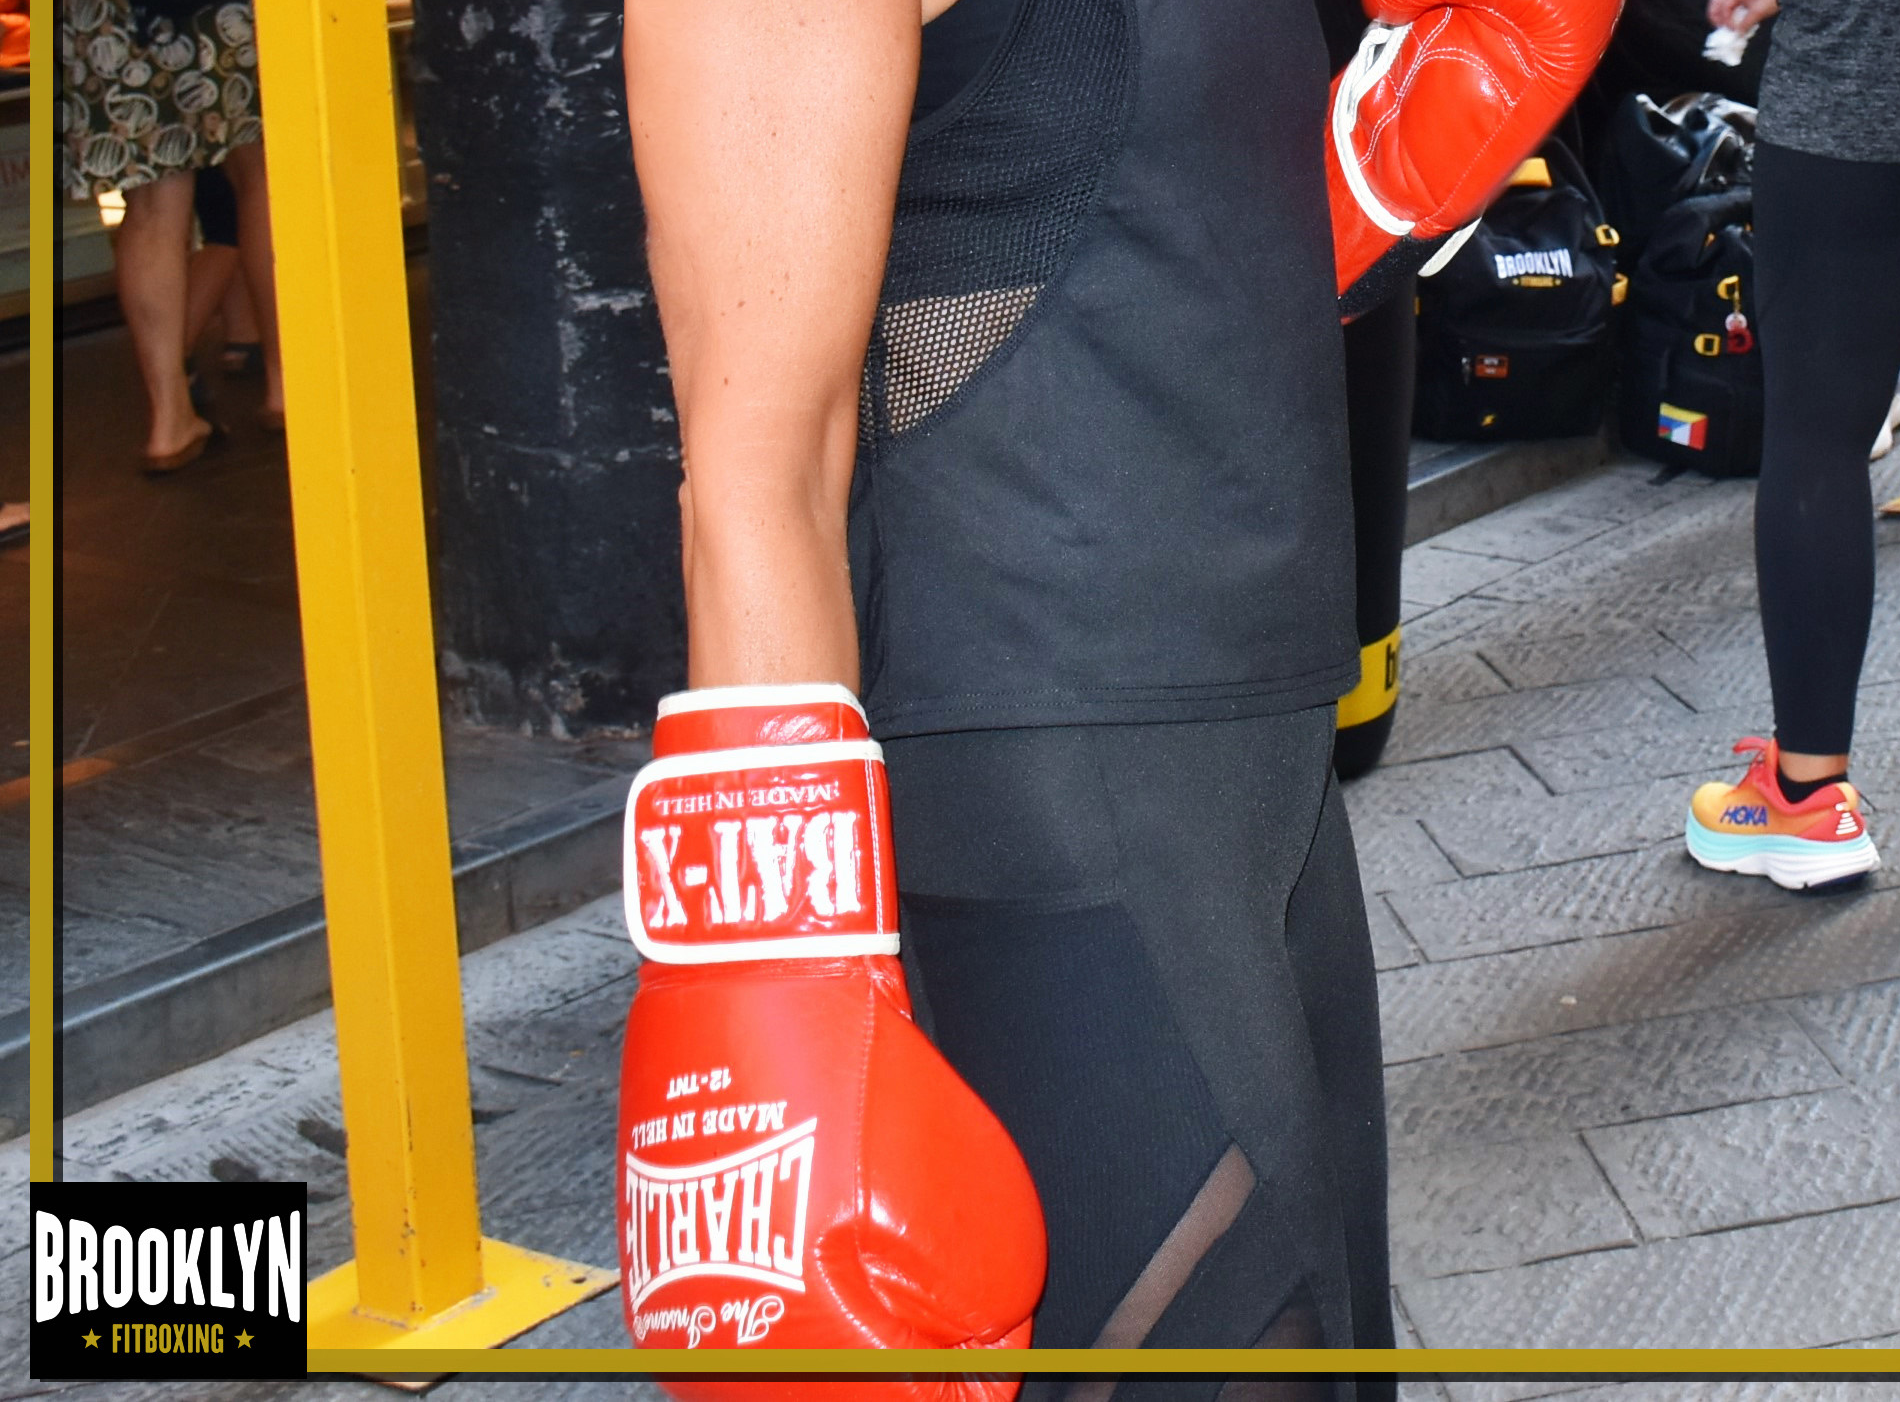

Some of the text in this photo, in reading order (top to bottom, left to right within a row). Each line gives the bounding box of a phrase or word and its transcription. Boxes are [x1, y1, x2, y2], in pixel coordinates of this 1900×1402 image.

[1495, 248, 1573, 279] BROOKLYN
[656, 784, 832, 816] MADE IN HELL
[1719, 806, 1769, 826] HOKA
[632, 1101, 787, 1150] MADE IN HELL
[626, 1135, 815, 1304] CHARLIE
[720, 1294, 785, 1346] The
